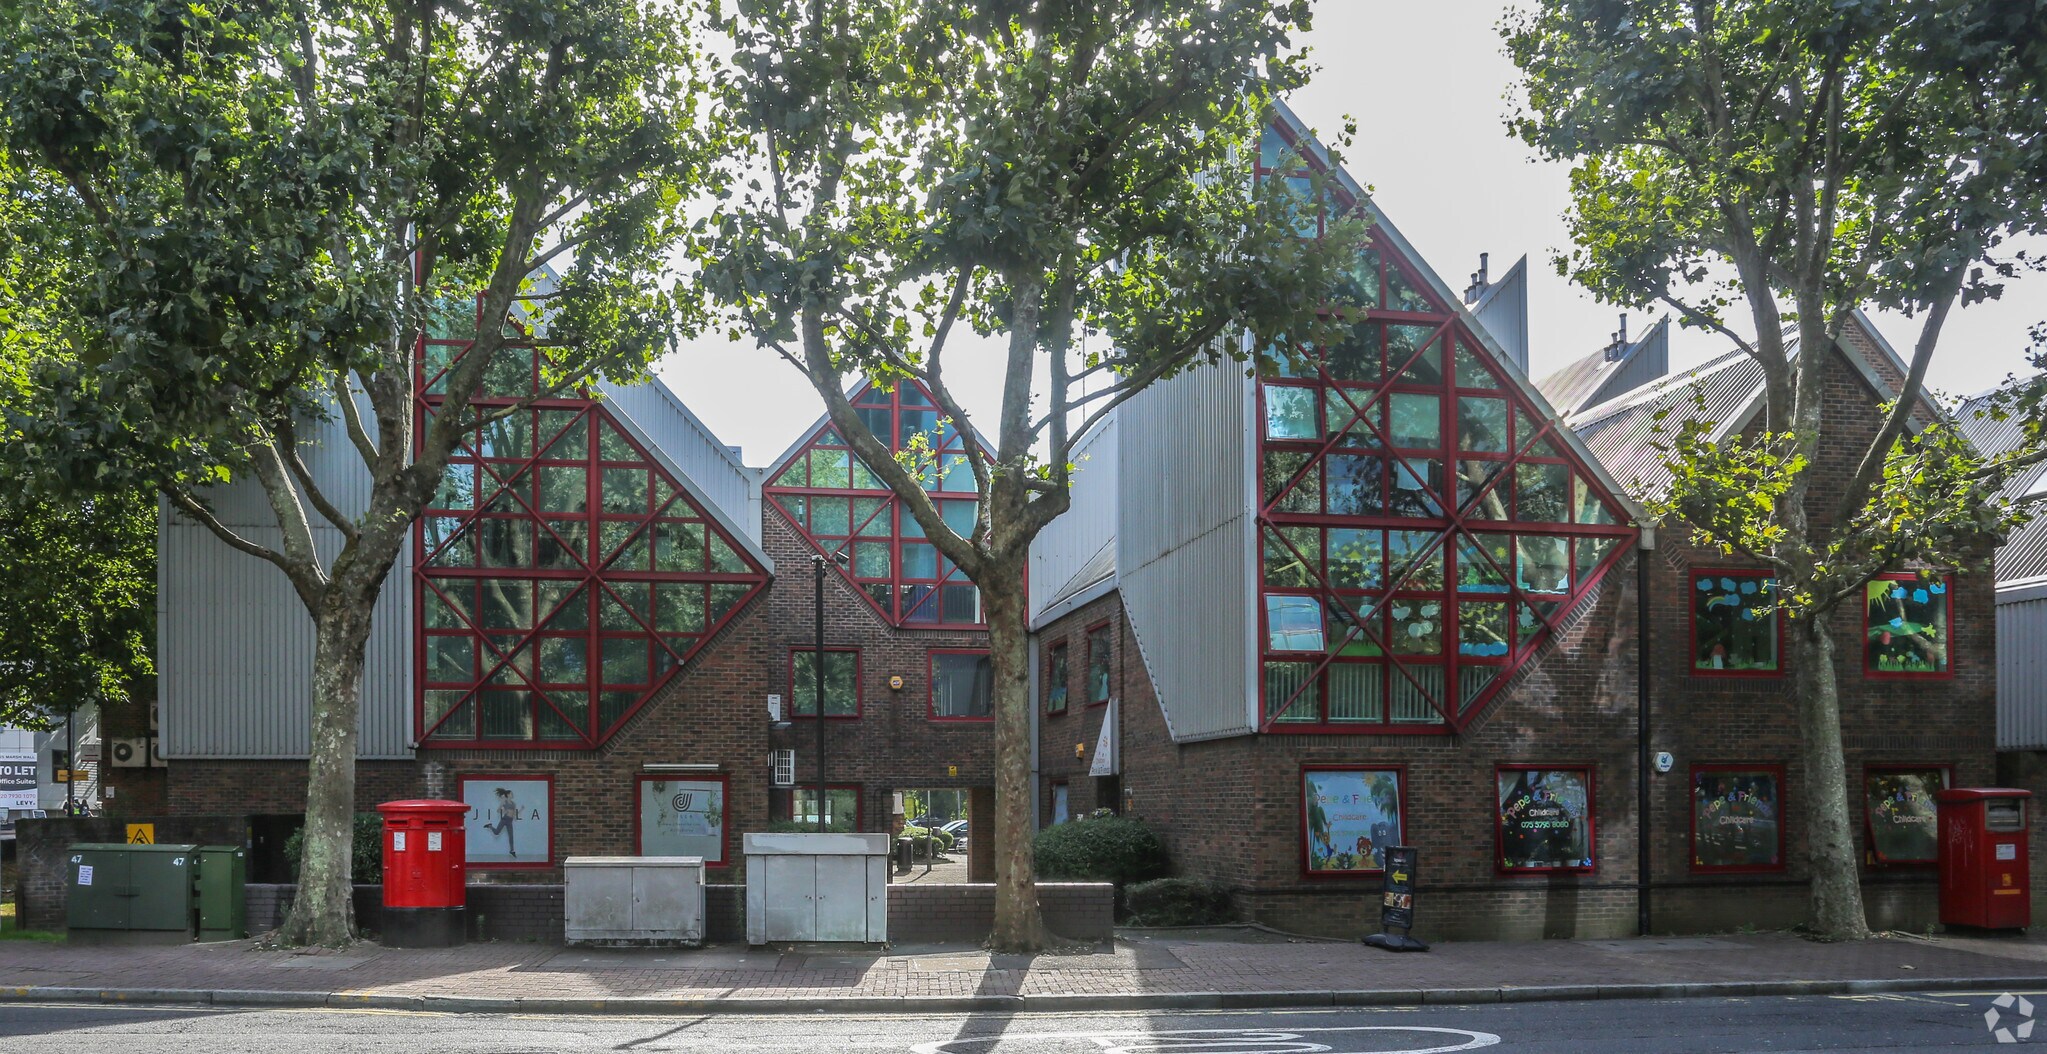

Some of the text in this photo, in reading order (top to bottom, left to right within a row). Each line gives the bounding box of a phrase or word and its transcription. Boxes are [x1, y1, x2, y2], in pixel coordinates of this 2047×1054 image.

[0, 766, 36, 776] TO LET
[1507, 795, 1531, 819] Pepe
[1533, 789, 1542, 801] &
[1702, 796, 1726, 819] Pepe
[1727, 791, 1737, 802] &
[1875, 796, 1895, 818] Pepe
[1896, 792, 1905, 802] &
[473, 808, 540, 821] JILLA
[1719, 815, 1754, 825] Childcare
[70, 854, 83, 864] 47
[172, 857, 185, 866] 47
